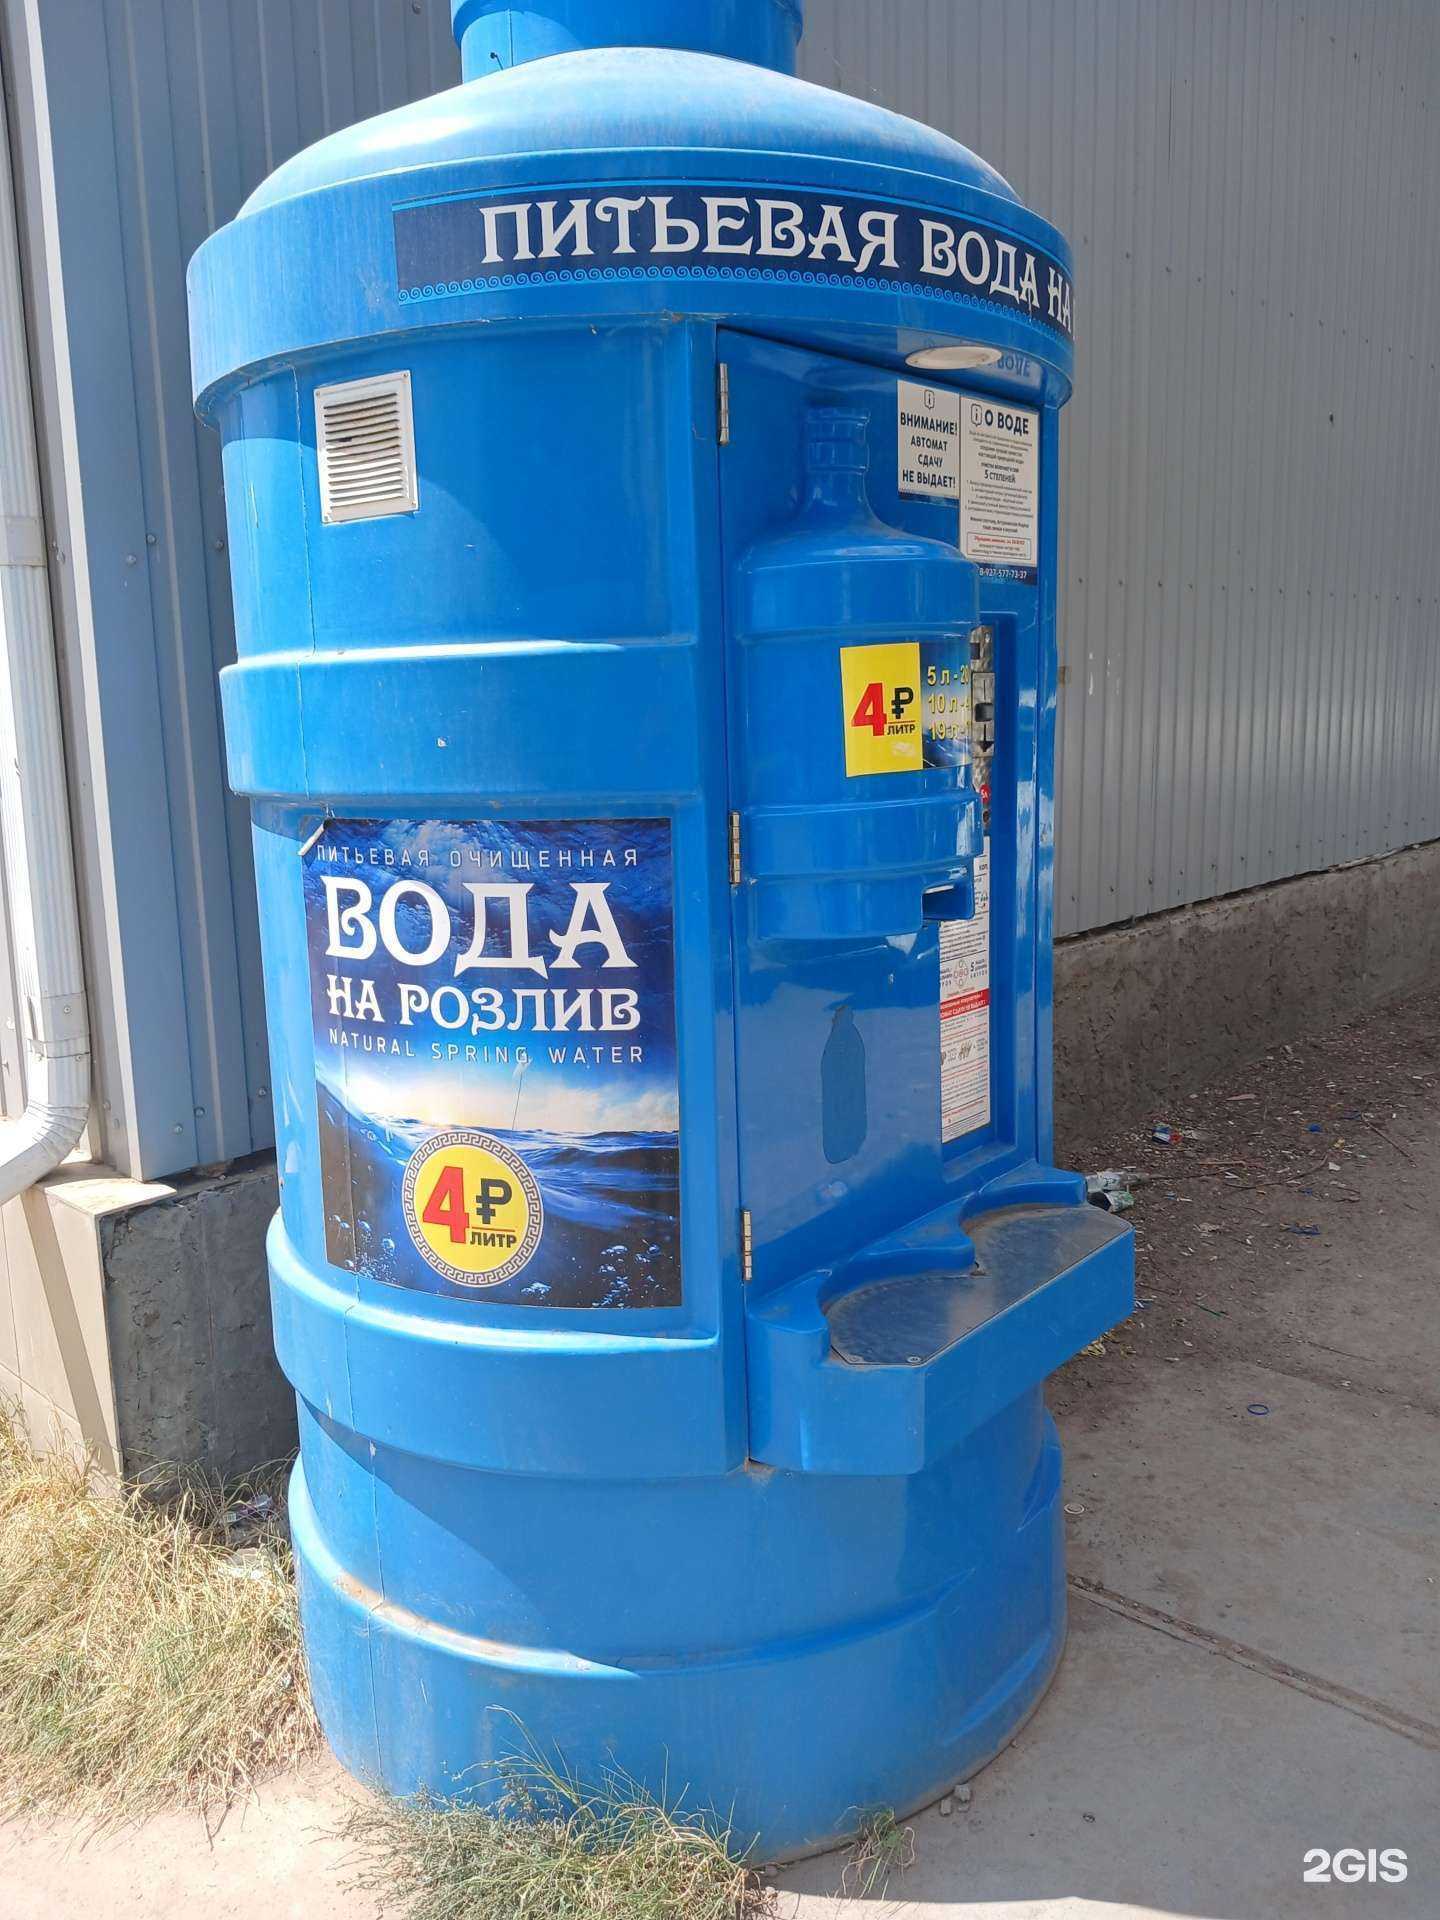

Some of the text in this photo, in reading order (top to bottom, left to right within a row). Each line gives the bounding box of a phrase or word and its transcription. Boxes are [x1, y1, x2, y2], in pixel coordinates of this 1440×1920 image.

[480, 195, 1072, 333] ПИТЬЕВАЯ ВОДА НА
[900, 412, 958, 436] ВНИМАНИЕ!
[984, 409, 1029, 436] О ВОДЕ
[911, 435, 948, 451] АВТОМАТ
[918, 454, 943, 467] СДАЧУ
[902, 470, 914, 483] НЕ
[916, 473, 956, 488] ВЫДАЕТ!
[984, 469, 989, 479] 5
[927, 665, 937, 686] 5
[928, 694, 945, 713] 10
[887, 724, 916, 736] ЛИТР
[316, 844, 638, 871] ПИТЬЕВАЯ ОЧИЩЕННАЯ
[320, 875, 639, 979] ВОДА
[326, 974, 641, 1036] НА РОЗЛИВ
[329, 1031, 644, 1065] NATURAL SPRING WATER
[470, 1231, 518, 1250] ЛИТР
